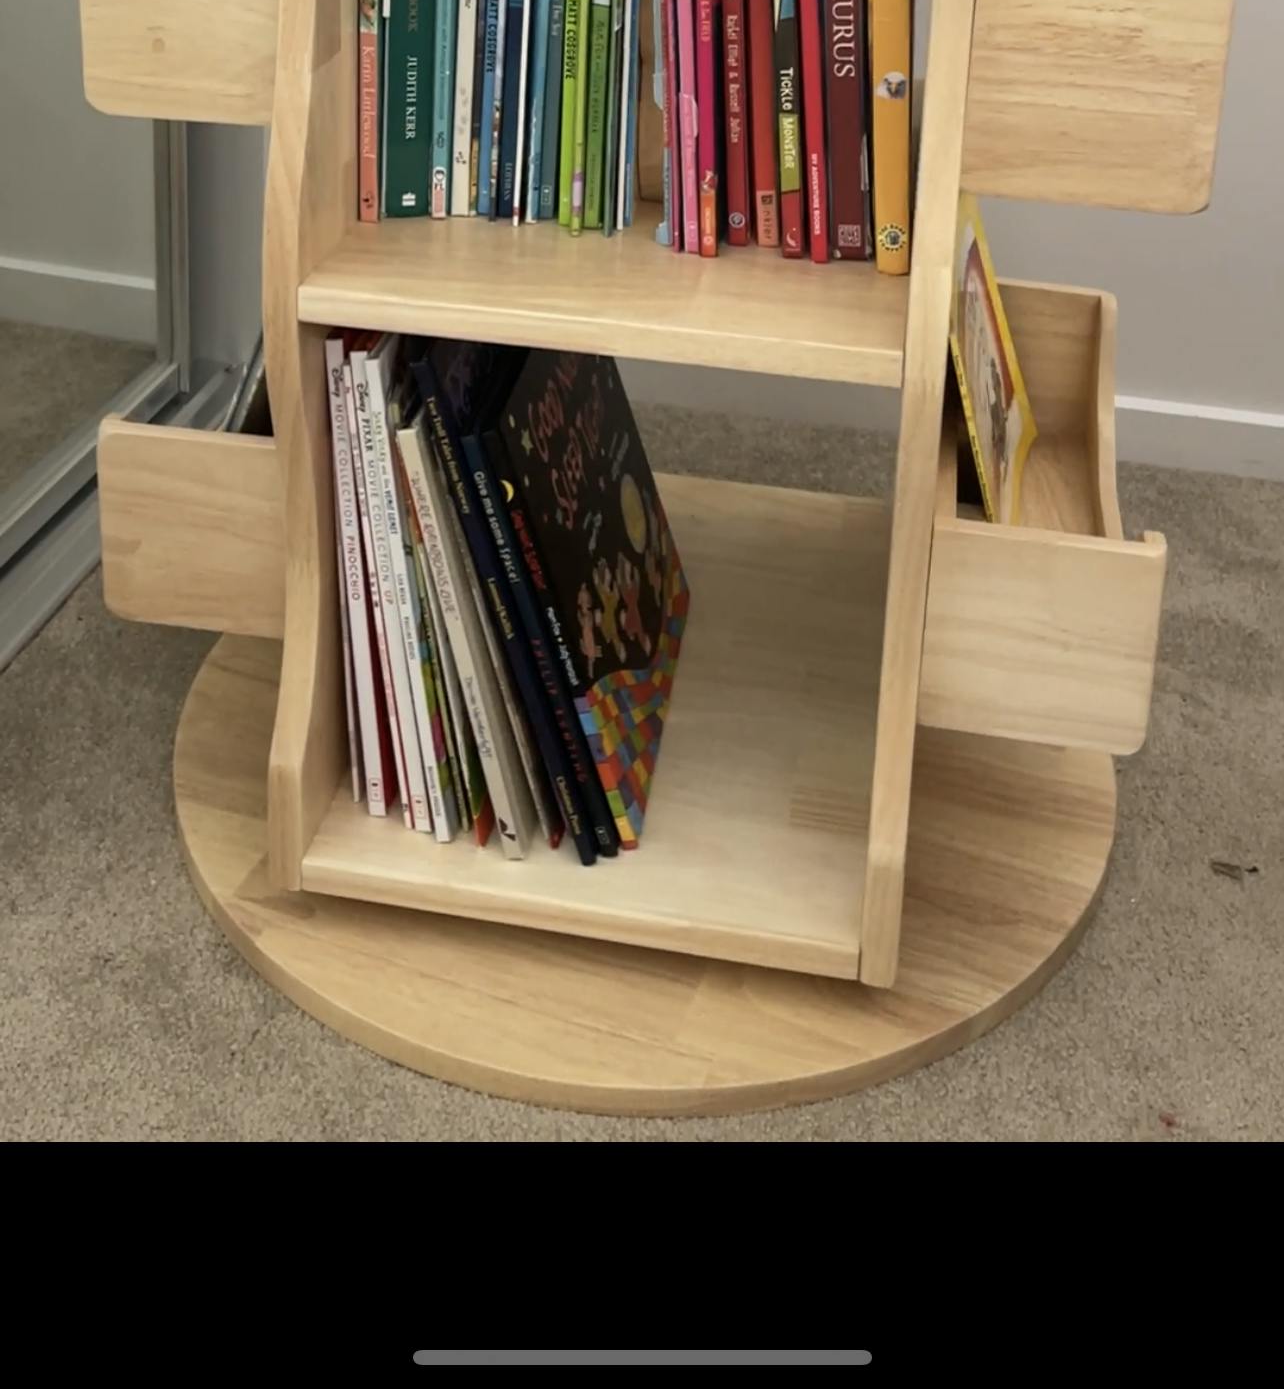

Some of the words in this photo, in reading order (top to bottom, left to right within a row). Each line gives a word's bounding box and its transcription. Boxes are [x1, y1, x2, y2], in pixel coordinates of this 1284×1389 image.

[361, 46, 376, 82] Karin
[484, 23, 498, 73] COSGROVE
[564, 29, 578, 80] COSGROVE
[404, 55, 419, 102] JUDITH
[728, 70, 739, 79] &
[404, 106, 418, 139] KERR
[810, 153, 818, 165] MY
[810, 165, 820, 209] ADVENTURE
[812, 209, 822, 236] BOOKS
[329, 365, 345, 398] Disney
[353, 379, 371, 414] Disney
[333, 403, 346, 444] MOVIE
[361, 418, 374, 453] PIXAR
[338, 448, 354, 528] COLLECTION
[364, 459, 380, 499] MOVIE
[472, 469, 492, 497] Give
[481, 496, 496, 517] me
[370, 504, 393, 583] COLLECTION
[487, 515, 508, 548] some
[344, 535, 363, 602] PINOCCHIO
[384, 589, 395, 606] UP
